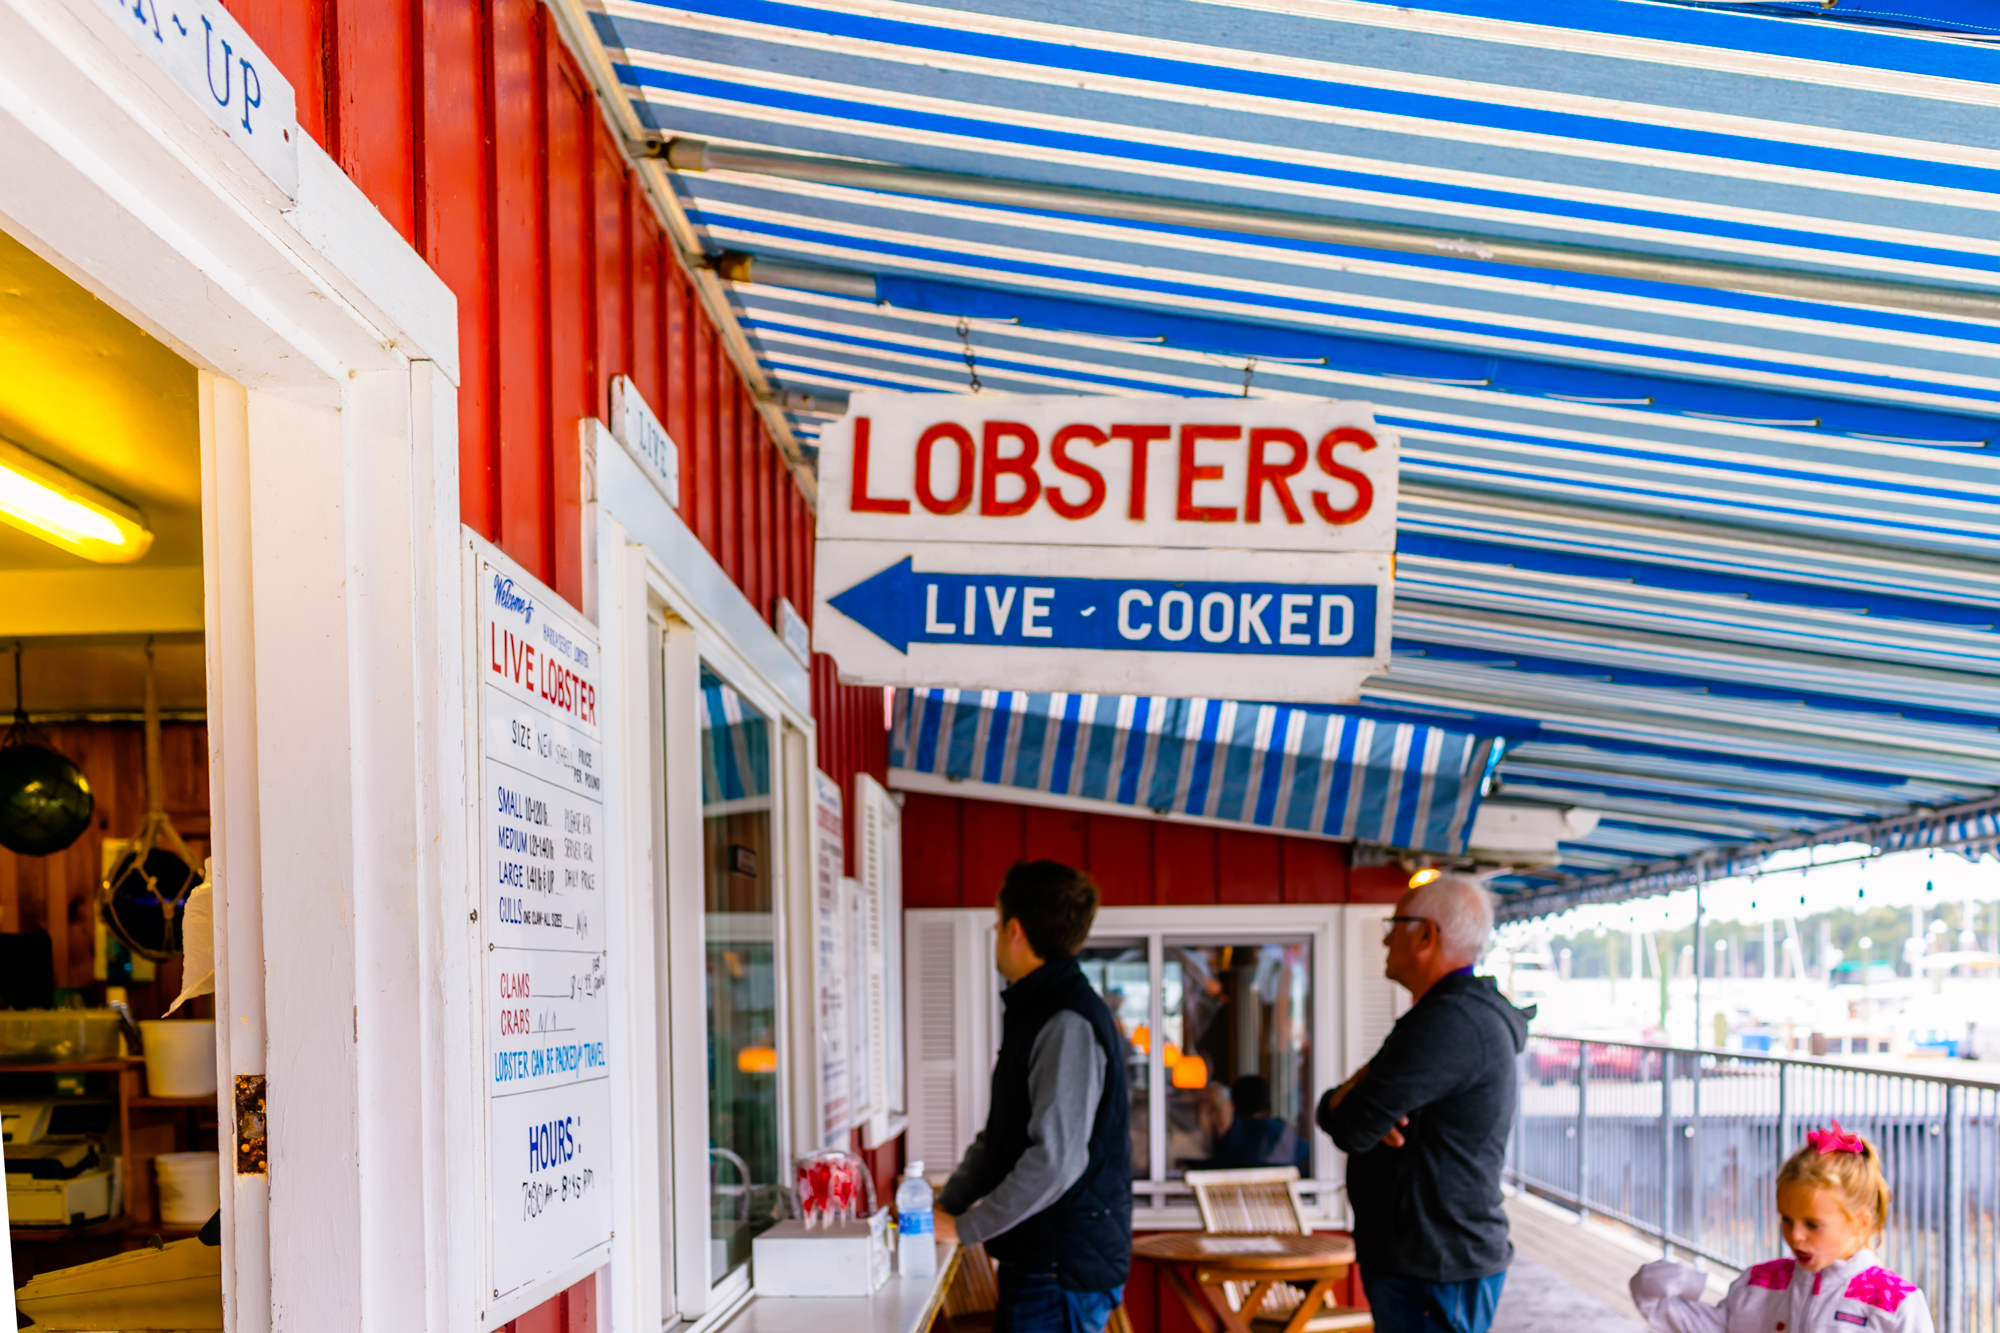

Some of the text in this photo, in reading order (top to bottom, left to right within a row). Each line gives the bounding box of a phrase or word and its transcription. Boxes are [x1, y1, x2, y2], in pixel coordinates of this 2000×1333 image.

[639, 410, 668, 479] LIVE
[849, 415, 1379, 526] LOBSTERS
[493, 573, 526, 615] Welcome
[924, 583, 1056, 638] LIVE
[1117, 588, 1355, 647] COOKED
[491, 620, 596, 728] LIVE LOBSTER
[512, 719, 531, 750] SIZE
[578, 748, 592, 769] PRICE
[498, 785, 523, 819] SMALL
[498, 825, 528, 855] MEDIUM
[498, 860, 524, 888] LARGE
[499, 896, 523, 925] CULLS
[500, 972, 530, 999] CLAMS
[500, 1008, 530, 1036] CRABS
[494, 1050, 529, 1082] LOBSTER
[531, 1048, 544, 1077] CAN
[546, 1047, 555, 1075] BE
[584, 1041, 606, 1068] TRAVEL
[529, 1116, 582, 1174] HOURS:
